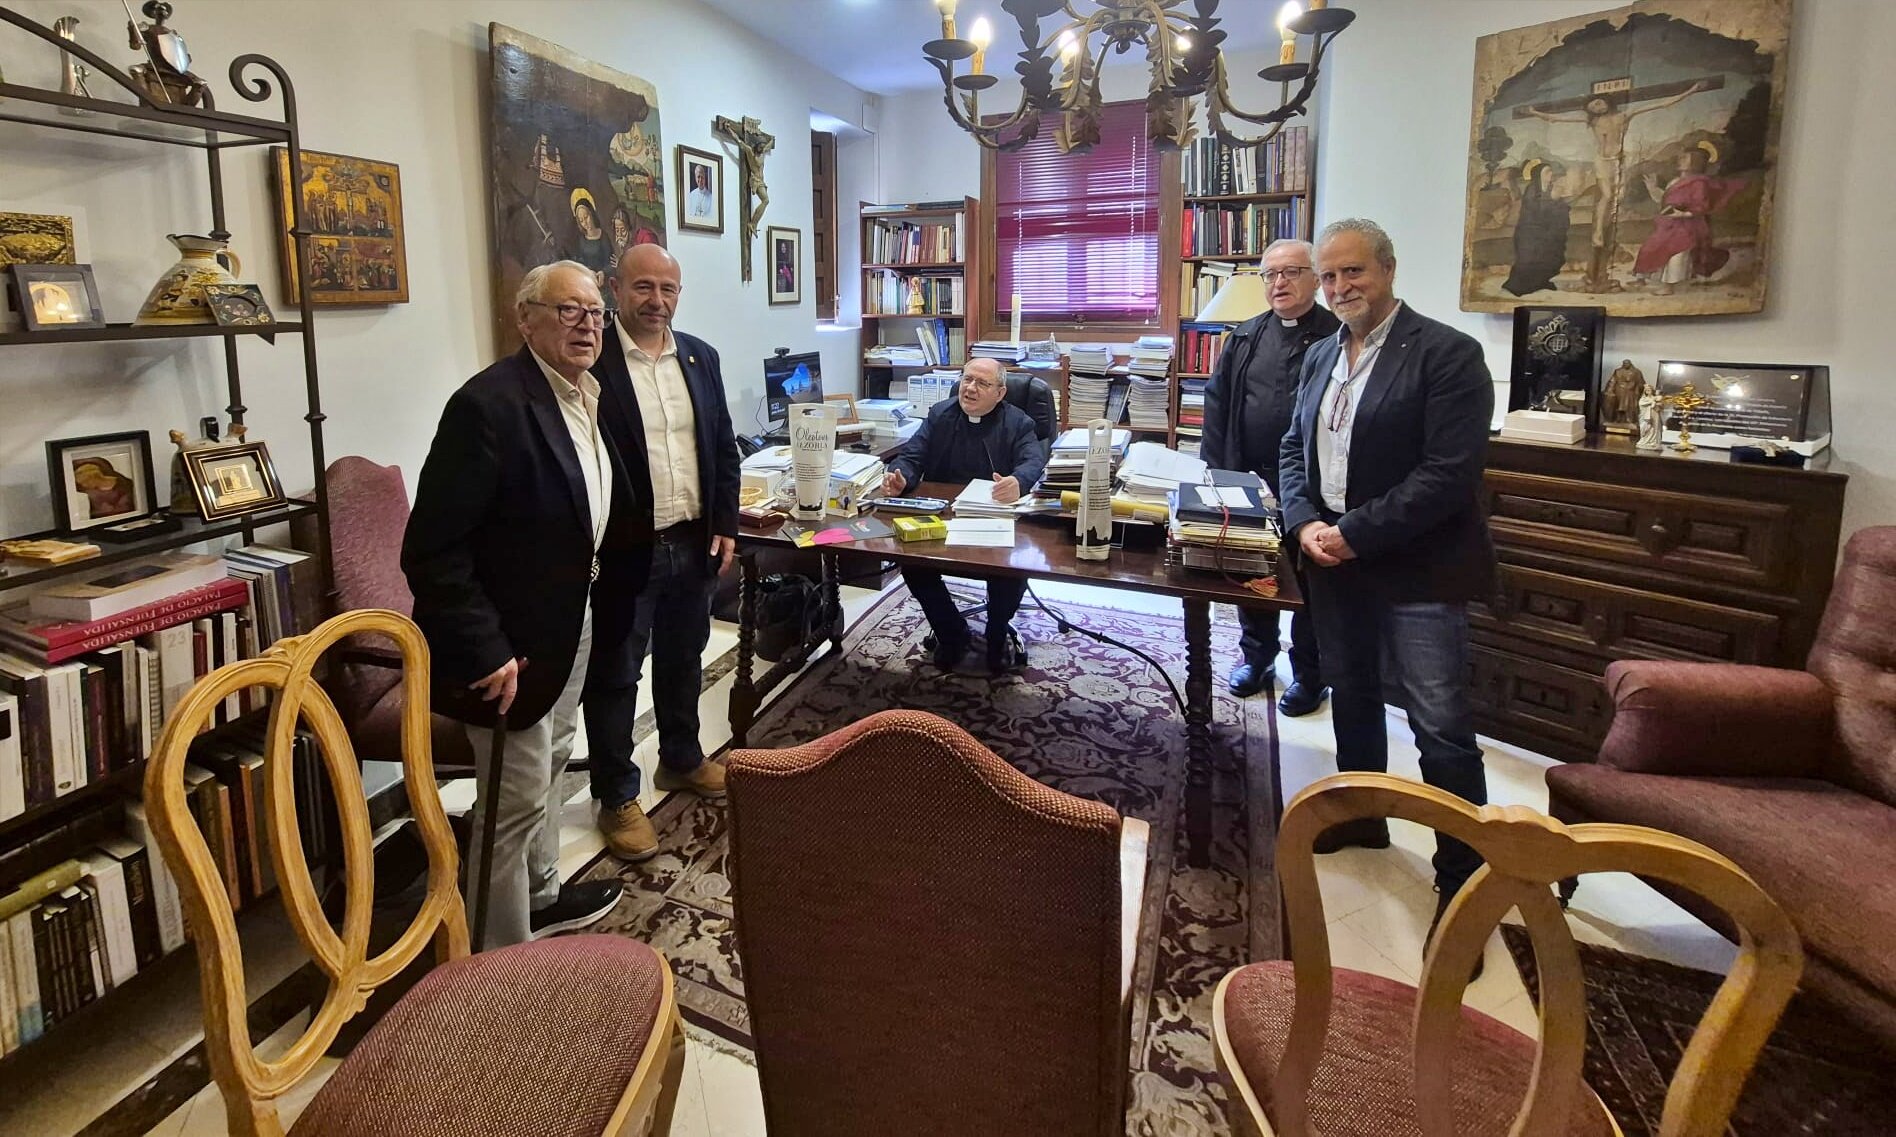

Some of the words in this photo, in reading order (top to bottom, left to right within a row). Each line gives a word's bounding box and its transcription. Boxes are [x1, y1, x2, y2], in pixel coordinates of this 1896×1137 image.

[177, 590, 221, 609] PALACIO
[161, 604, 174, 614] DE
[177, 602, 221, 621] PALACIO
[160, 617, 174, 627] DE
[168, 631, 187, 648] 23
